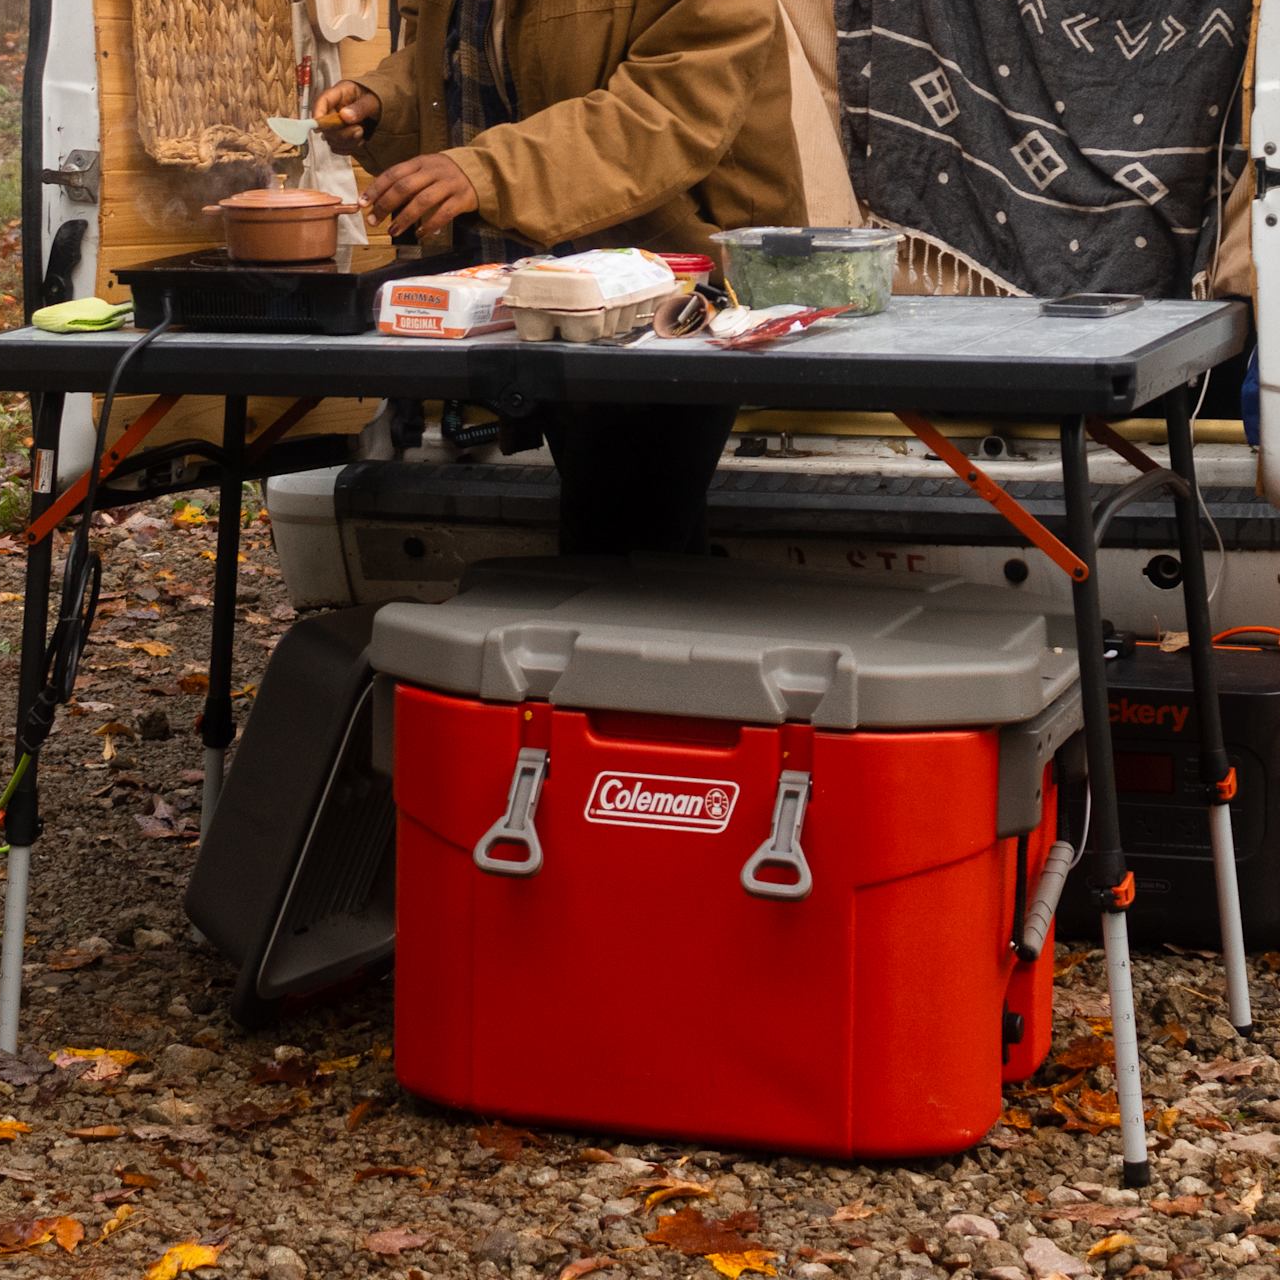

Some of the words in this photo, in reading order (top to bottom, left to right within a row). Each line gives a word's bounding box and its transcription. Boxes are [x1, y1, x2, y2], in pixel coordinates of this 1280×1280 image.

[400, 316, 438, 330] ORIGINAL
[1108, 697, 1191, 732] ckery
[599, 778, 704, 816] Coleman
